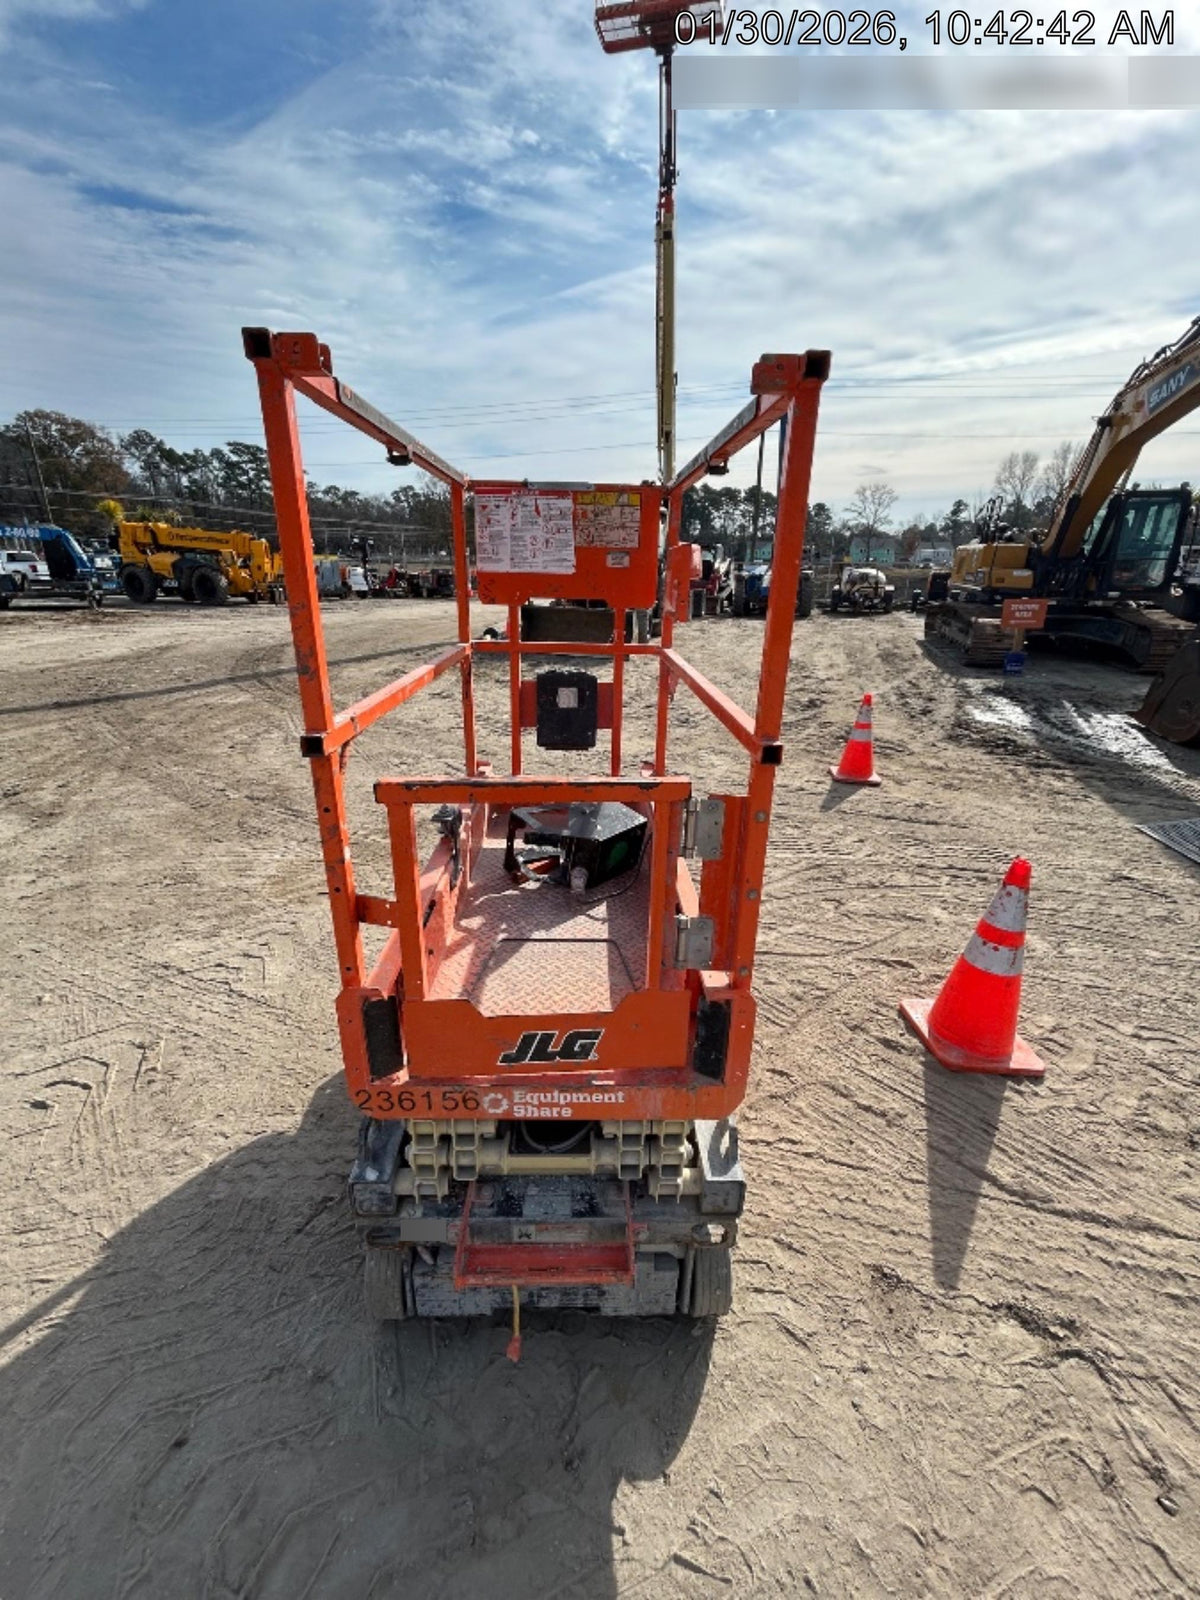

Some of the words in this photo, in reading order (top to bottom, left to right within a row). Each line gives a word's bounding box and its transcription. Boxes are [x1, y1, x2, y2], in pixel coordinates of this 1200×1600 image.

[1150, 365, 1190, 408] SANY
[497, 1028, 605, 1065] JLG
[355, 1089, 480, 1112] 236156
[513, 1089, 625, 1106] Equipment
[513, 1105, 573, 1118] Share
